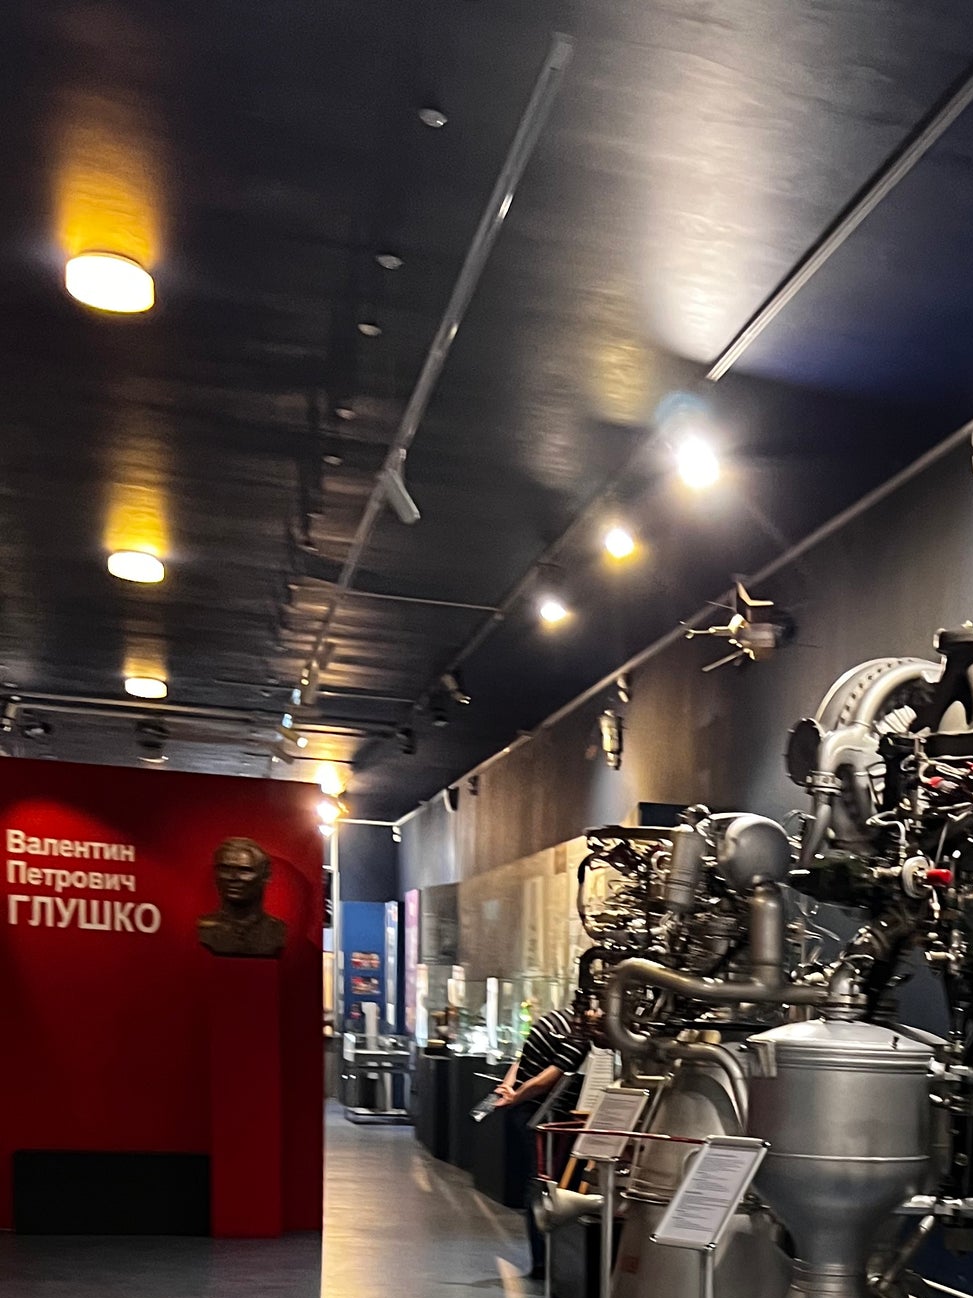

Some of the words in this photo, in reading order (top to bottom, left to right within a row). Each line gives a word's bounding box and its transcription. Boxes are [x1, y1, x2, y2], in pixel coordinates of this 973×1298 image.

[6, 829, 136, 862] Валентин
[6, 859, 136, 893] Петрович
[8, 894, 161, 934] ГЛУШКО
